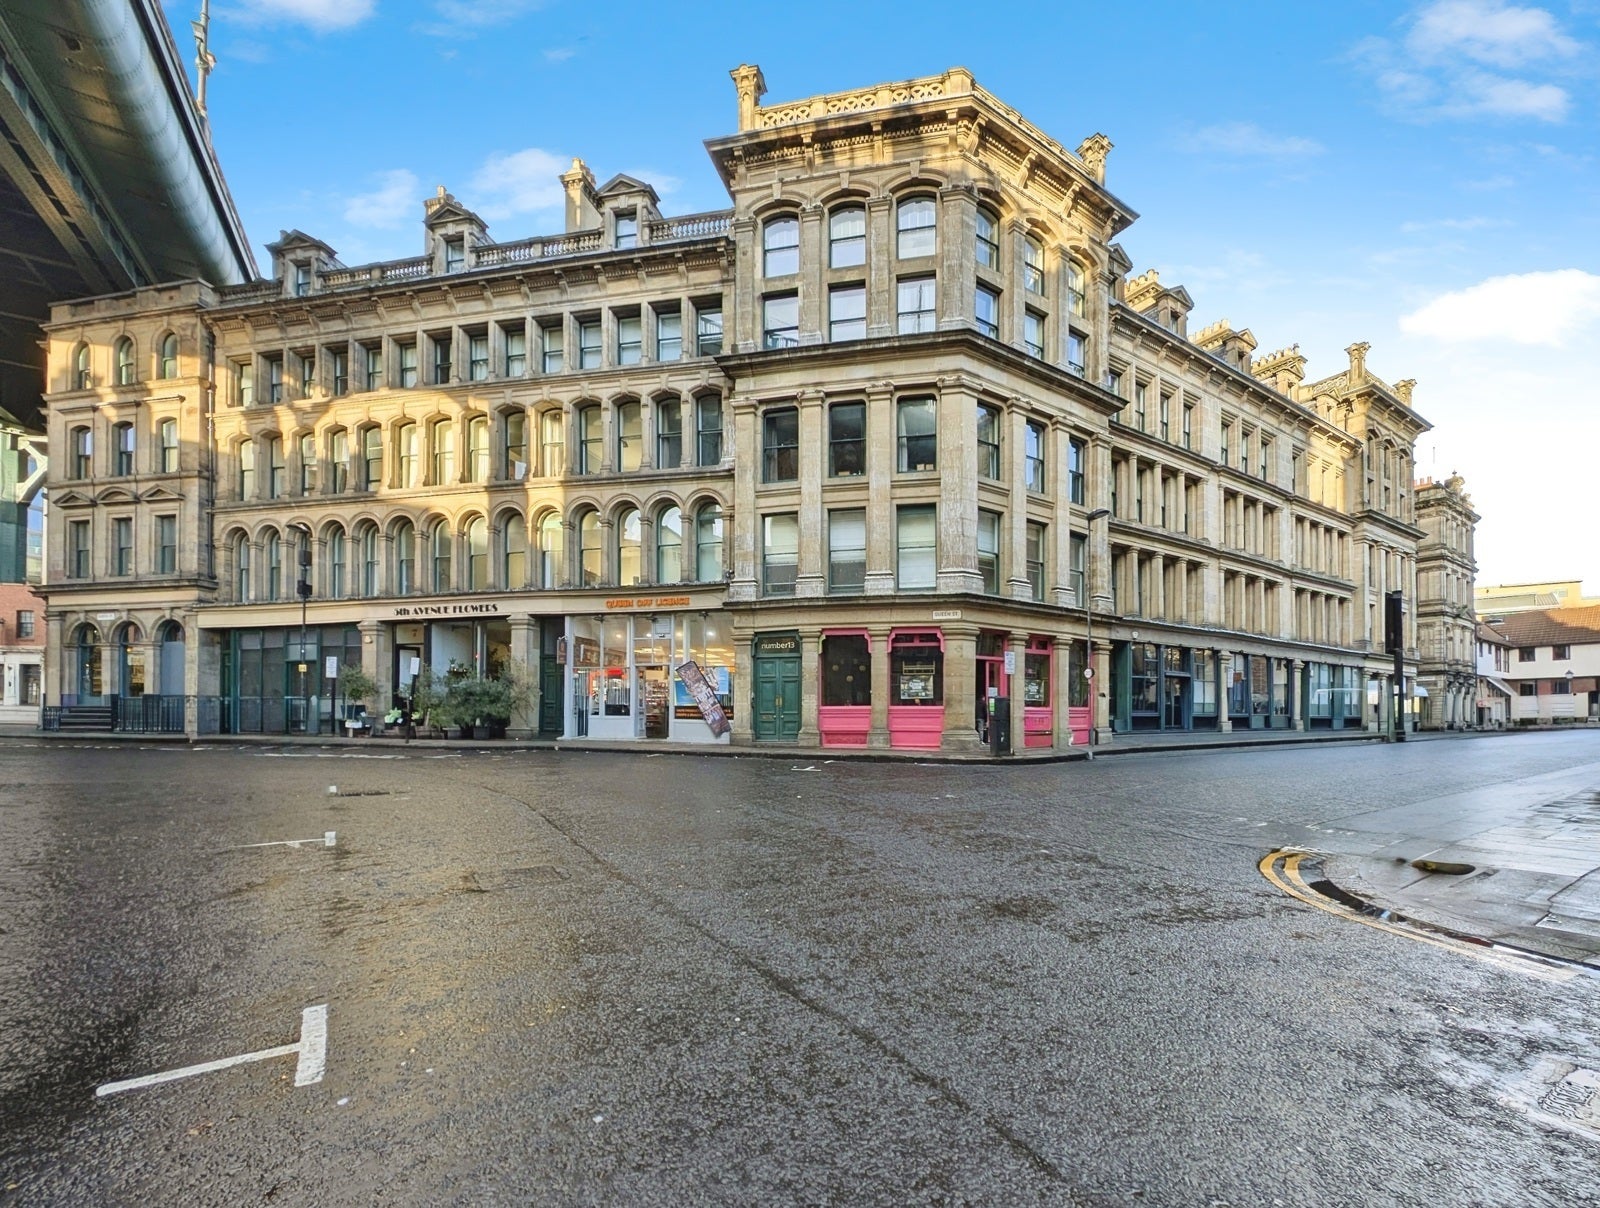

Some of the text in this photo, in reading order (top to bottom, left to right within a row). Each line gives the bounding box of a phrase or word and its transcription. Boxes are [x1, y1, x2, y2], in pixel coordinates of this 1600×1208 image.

[637, 598, 652, 607] OFF
[412, 605, 450, 615] AVENUE
[453, 603, 498, 613] FLOWERS
